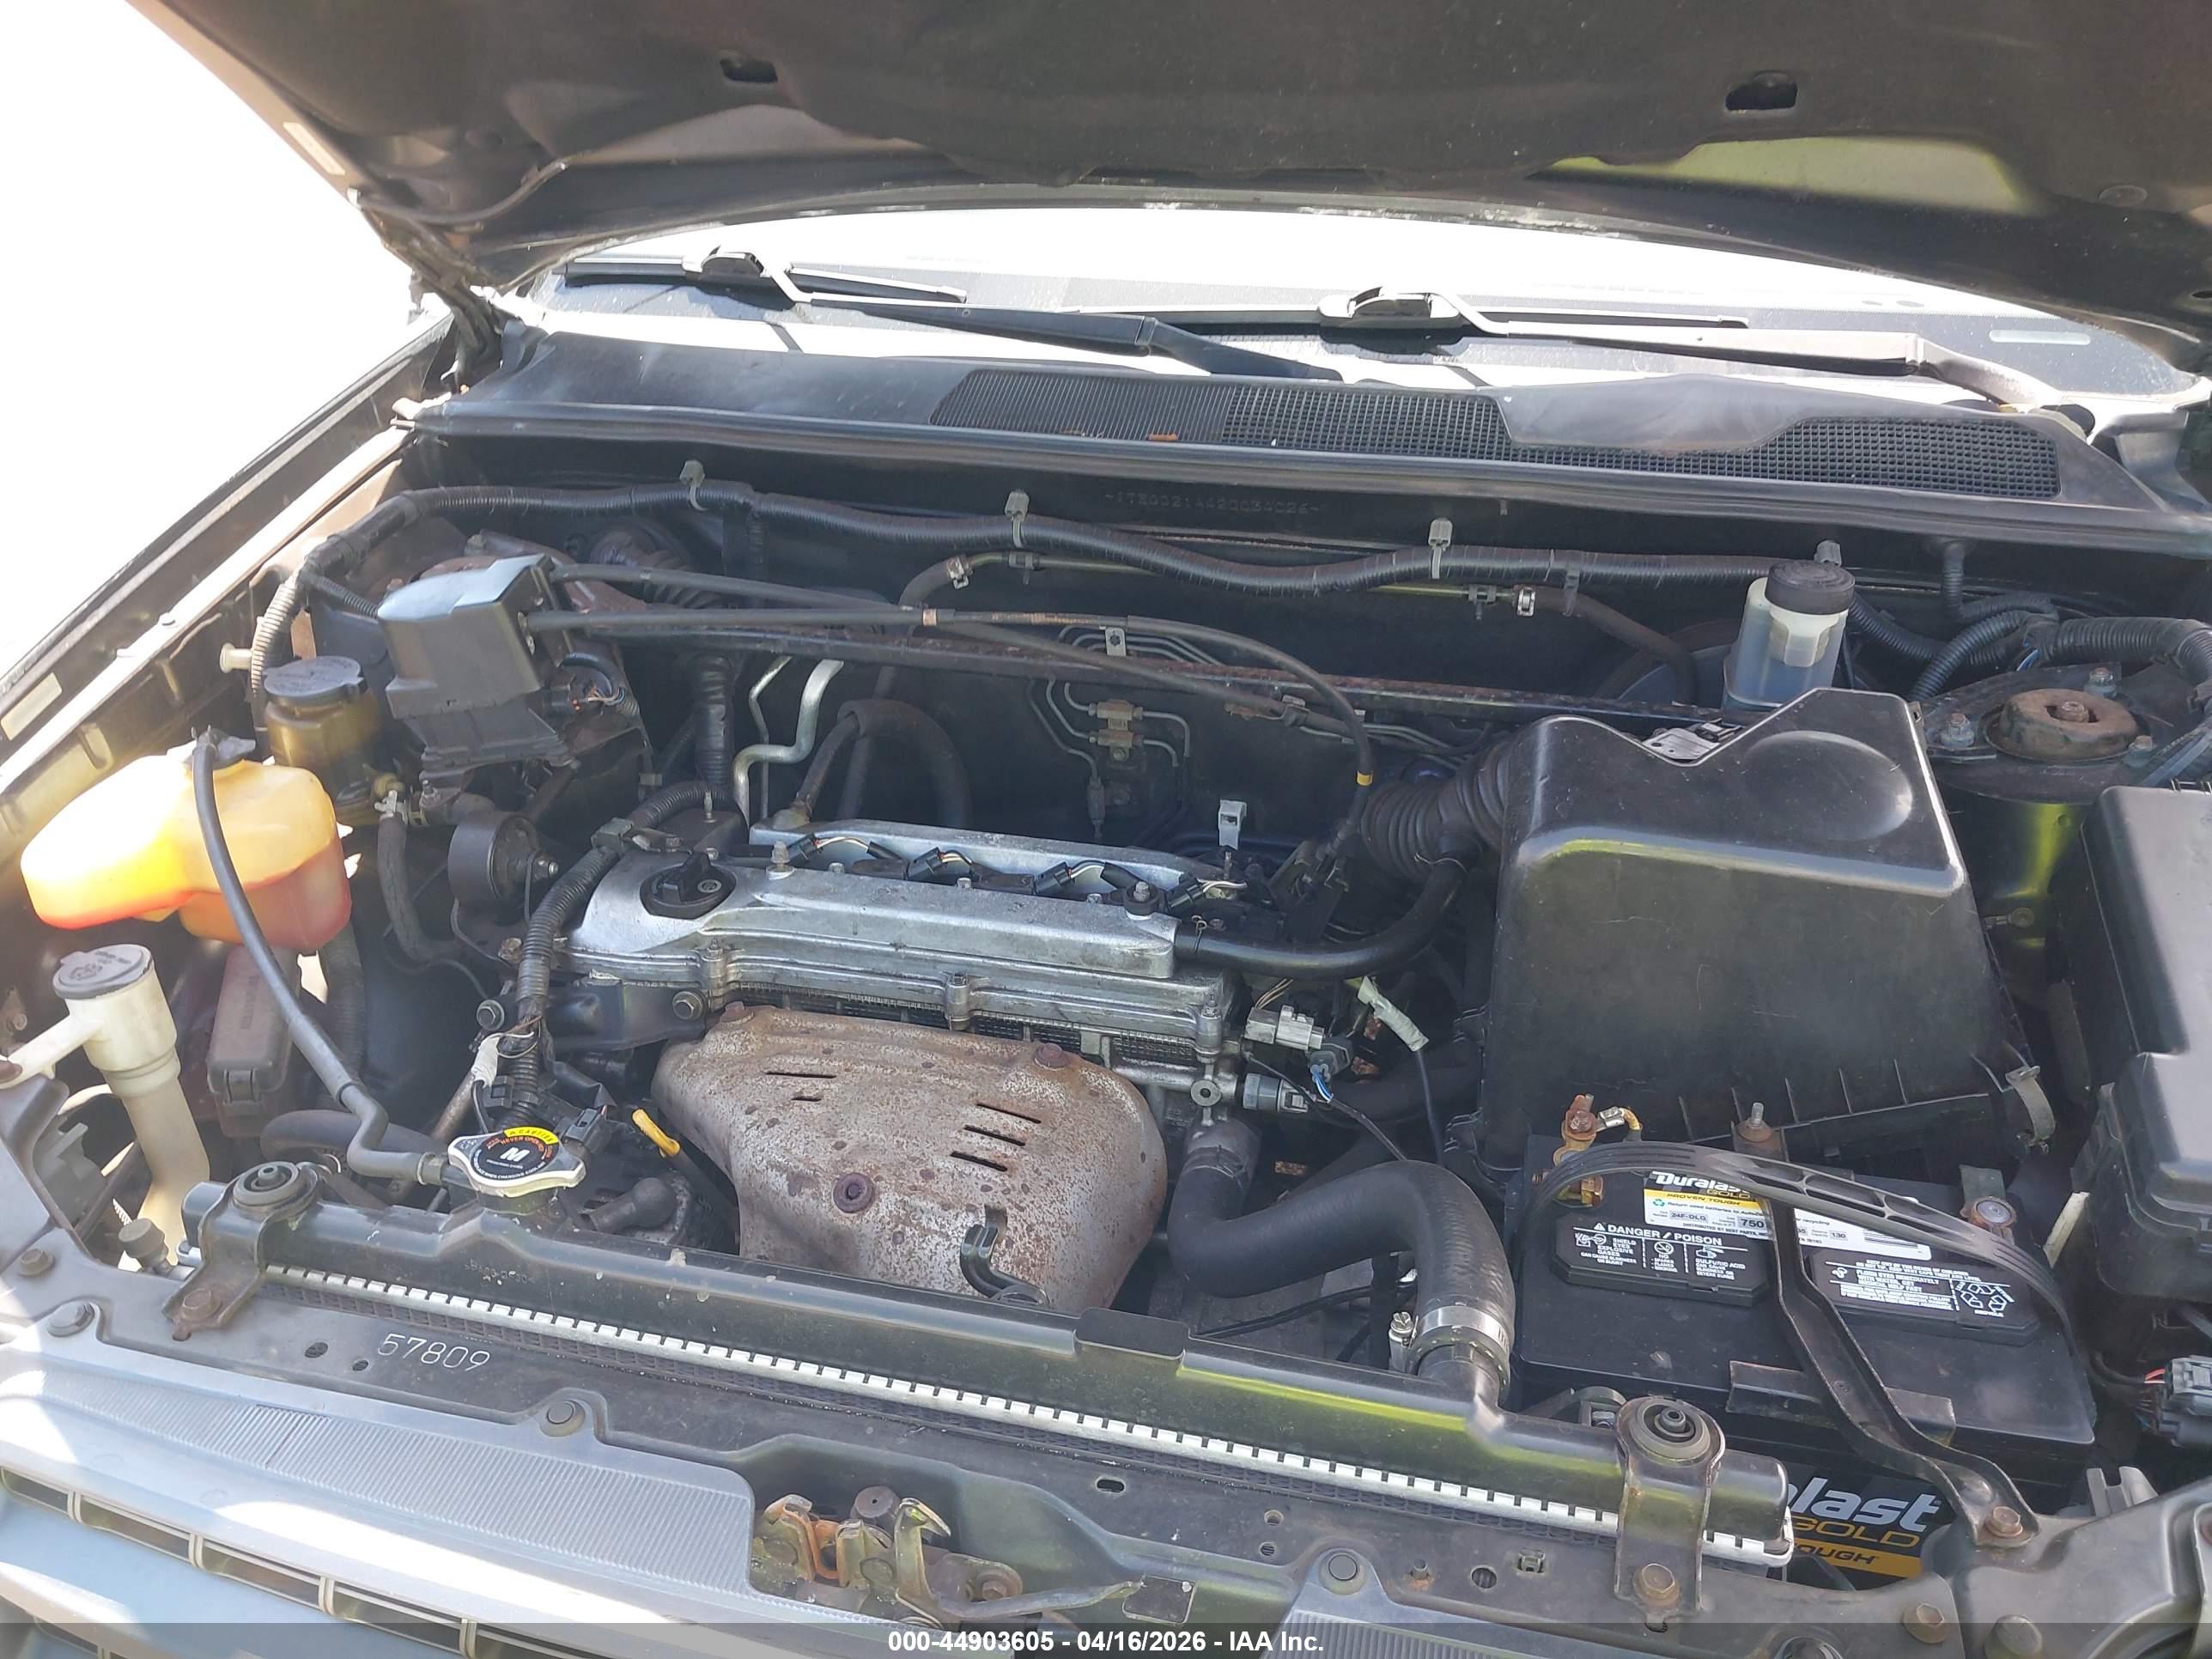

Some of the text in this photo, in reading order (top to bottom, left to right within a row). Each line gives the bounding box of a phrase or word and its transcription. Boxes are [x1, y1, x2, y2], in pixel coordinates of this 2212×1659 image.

[500, 1147, 530, 1162] M
[1705, 1189, 1751, 1199] GOLD
[1708, 1197, 1741, 1206] TOUGH
[1741, 1218, 1765, 1229] 750
[1608, 1224, 1661, 1237] DANGER
[1674, 1233, 1723, 1245] POISON
[1597, 1245, 1634, 1254] EXPLOSIVE
[1695, 1258, 1728, 1267] SULFURIC
[377, 1333, 491, 1372] 57809
[1793, 1516, 1920, 1547] GOLD
